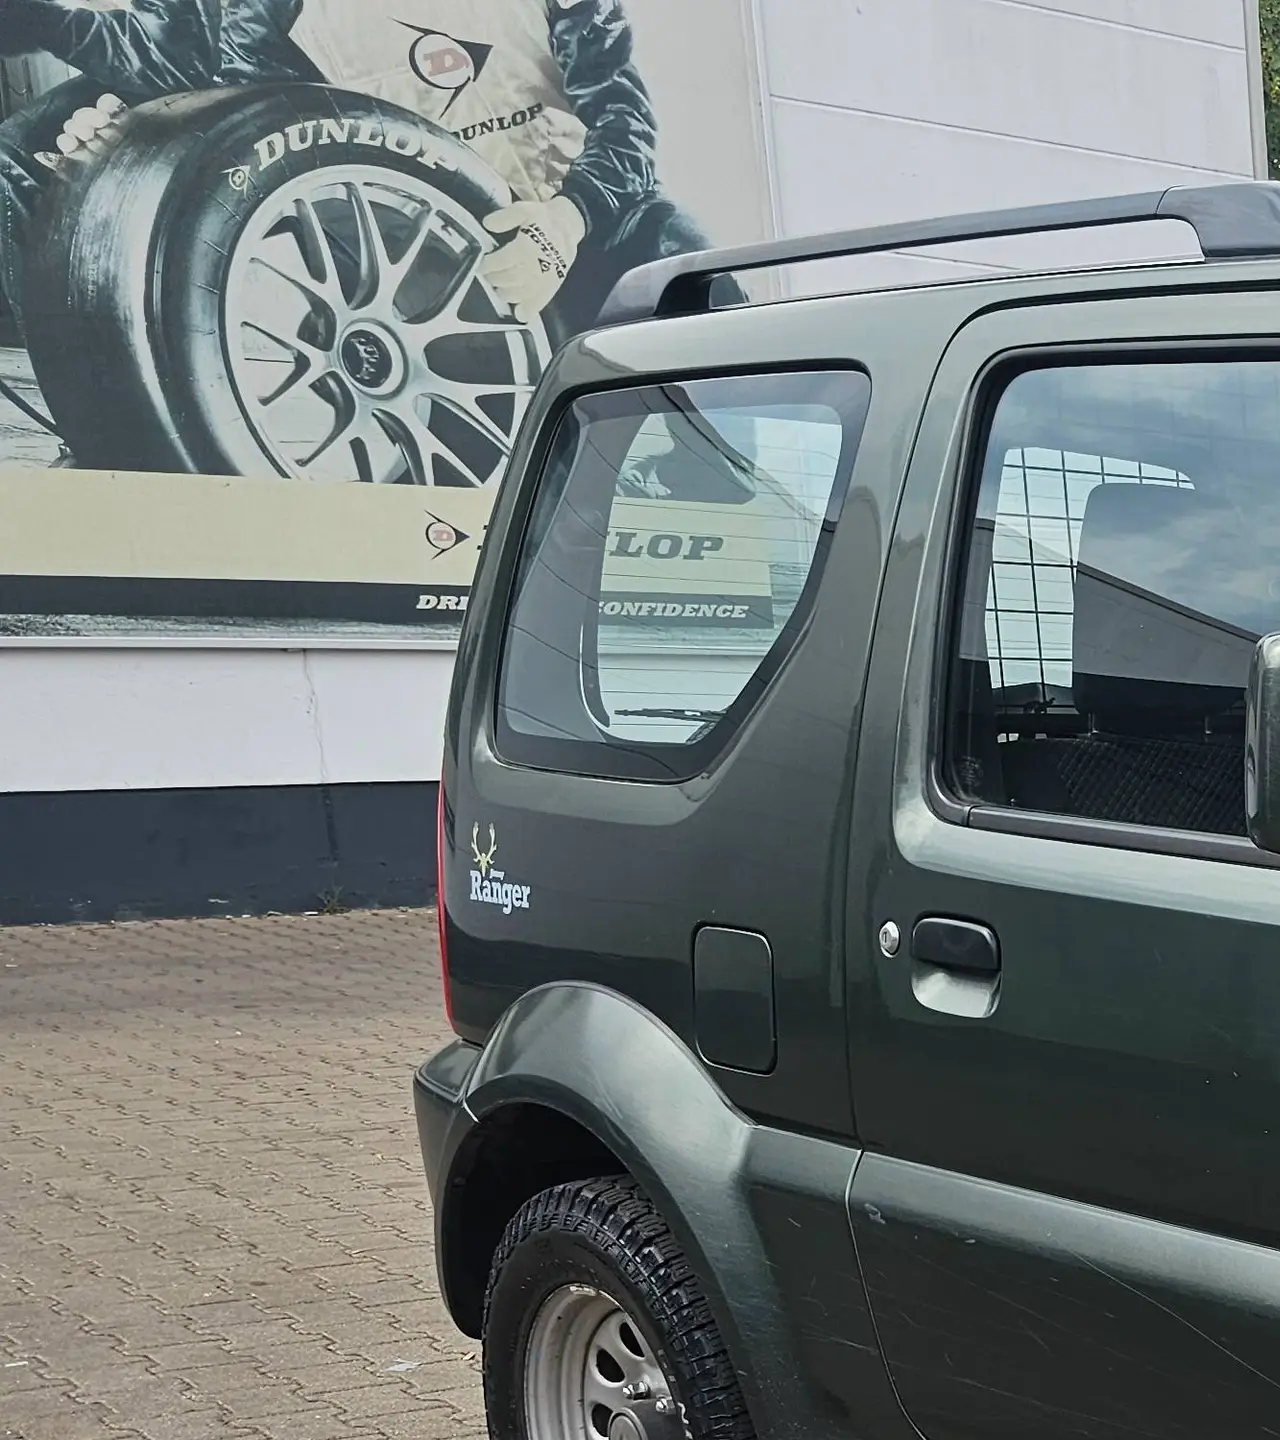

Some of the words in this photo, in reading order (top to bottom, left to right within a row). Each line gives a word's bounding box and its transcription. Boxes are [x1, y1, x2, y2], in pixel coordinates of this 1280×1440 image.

[253, 118, 460, 171] DUNLOP
[606, 531, 724, 560] LOP
[416, 594, 469, 610] DRI
[470, 869, 531, 915] Ranger
